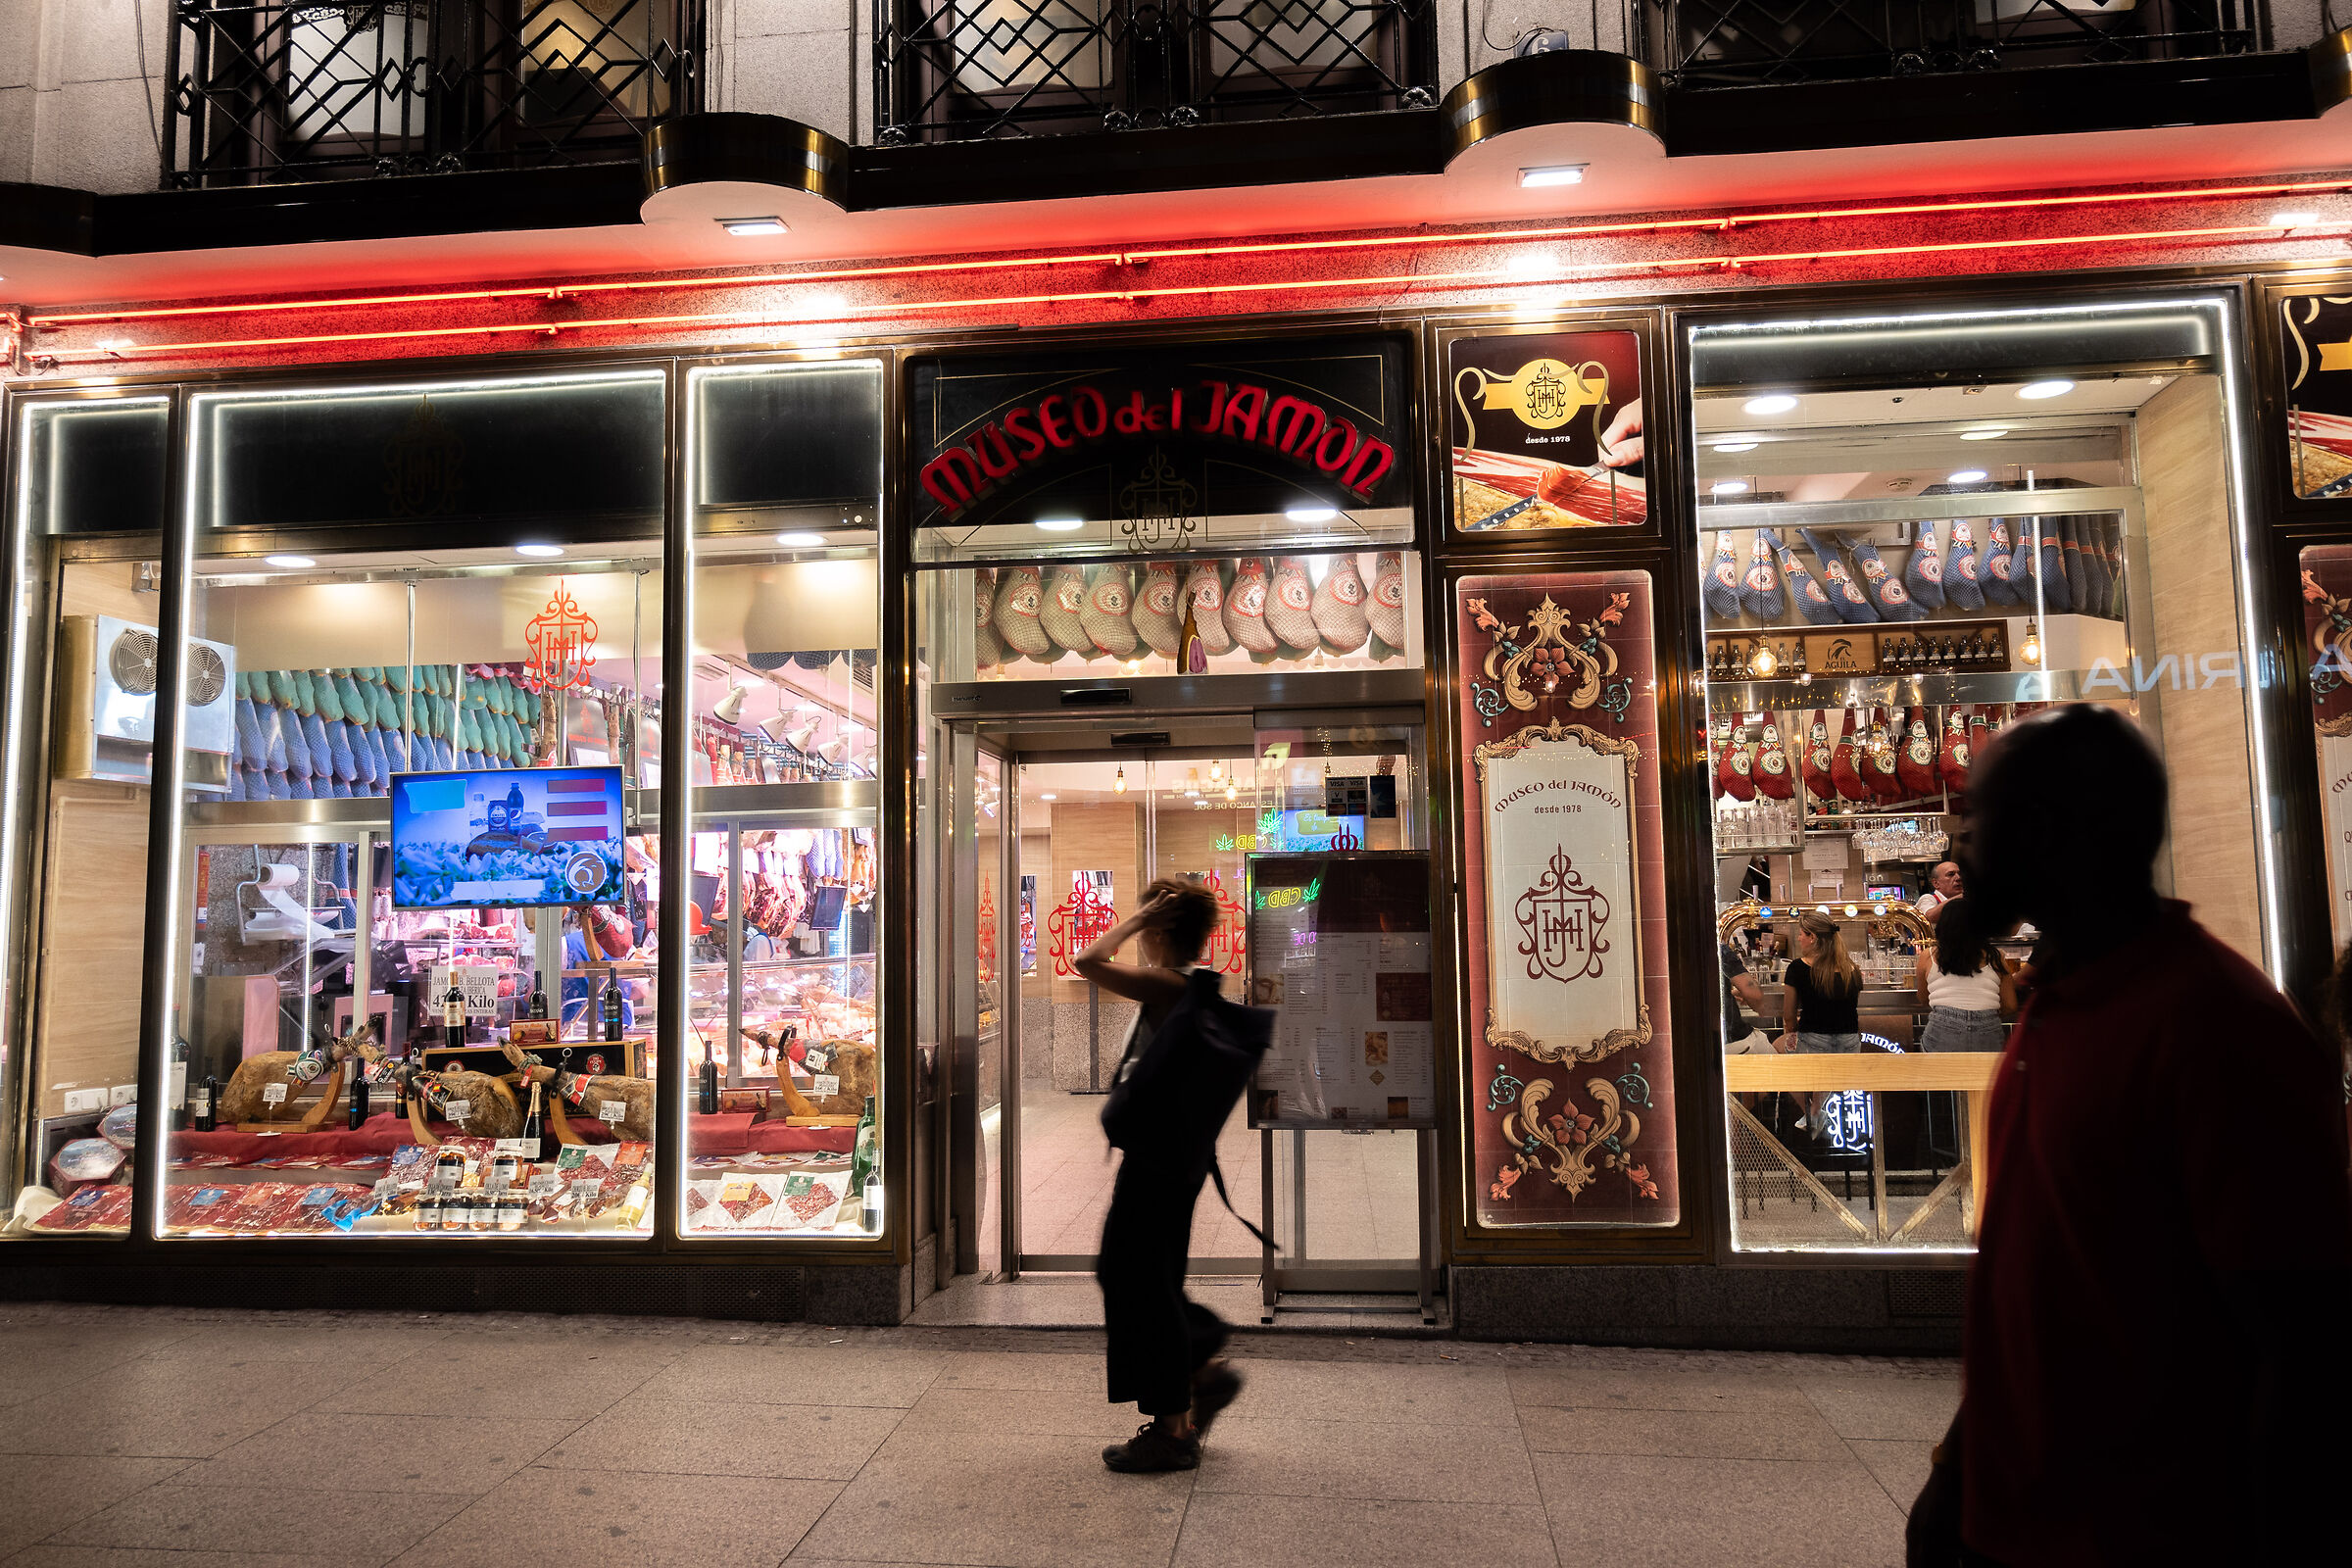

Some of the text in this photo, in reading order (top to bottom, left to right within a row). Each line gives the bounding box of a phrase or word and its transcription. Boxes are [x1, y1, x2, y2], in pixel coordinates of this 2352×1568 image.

[1525, 433, 1571, 444] desde 1978
[920, 386, 1107, 517] MUSEO
[1113, 389, 1182, 434] del
[1494, 779, 1622, 812] MUSEO del JAMÓN
[1534, 805, 1582, 814] desde 1978
[466, 976, 495, 986] BELLOTA
[467, 995, 495, 1008] Kilo
